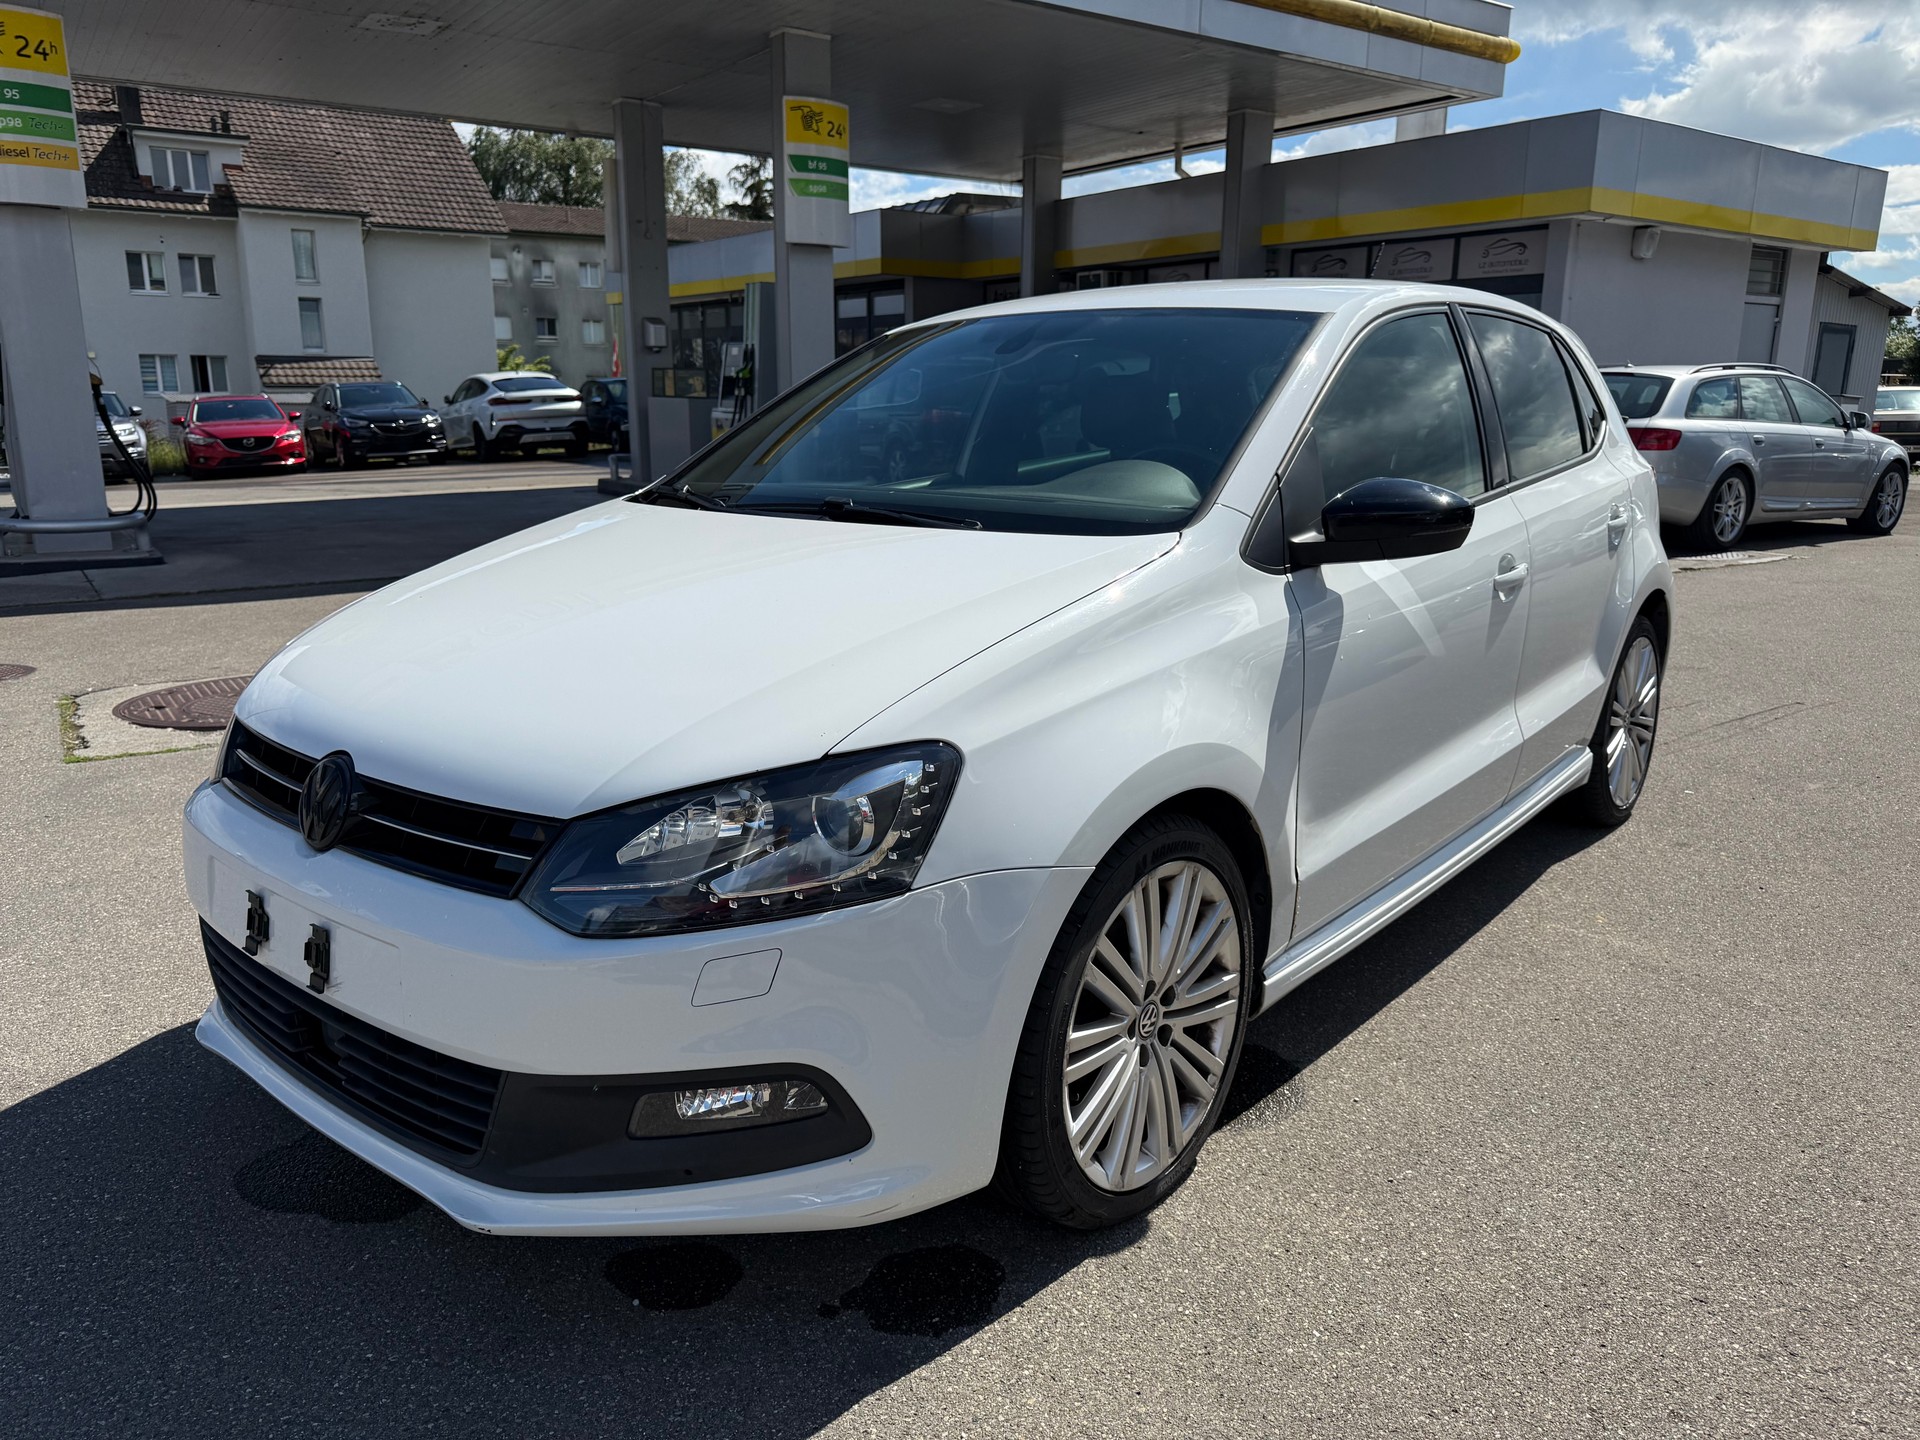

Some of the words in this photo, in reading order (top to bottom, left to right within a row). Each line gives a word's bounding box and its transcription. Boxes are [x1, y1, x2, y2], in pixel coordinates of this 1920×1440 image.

[3, 88, 20, 100] 95
[28, 117, 66, 131] Tech+
[32, 147, 70, 161] Tech+
